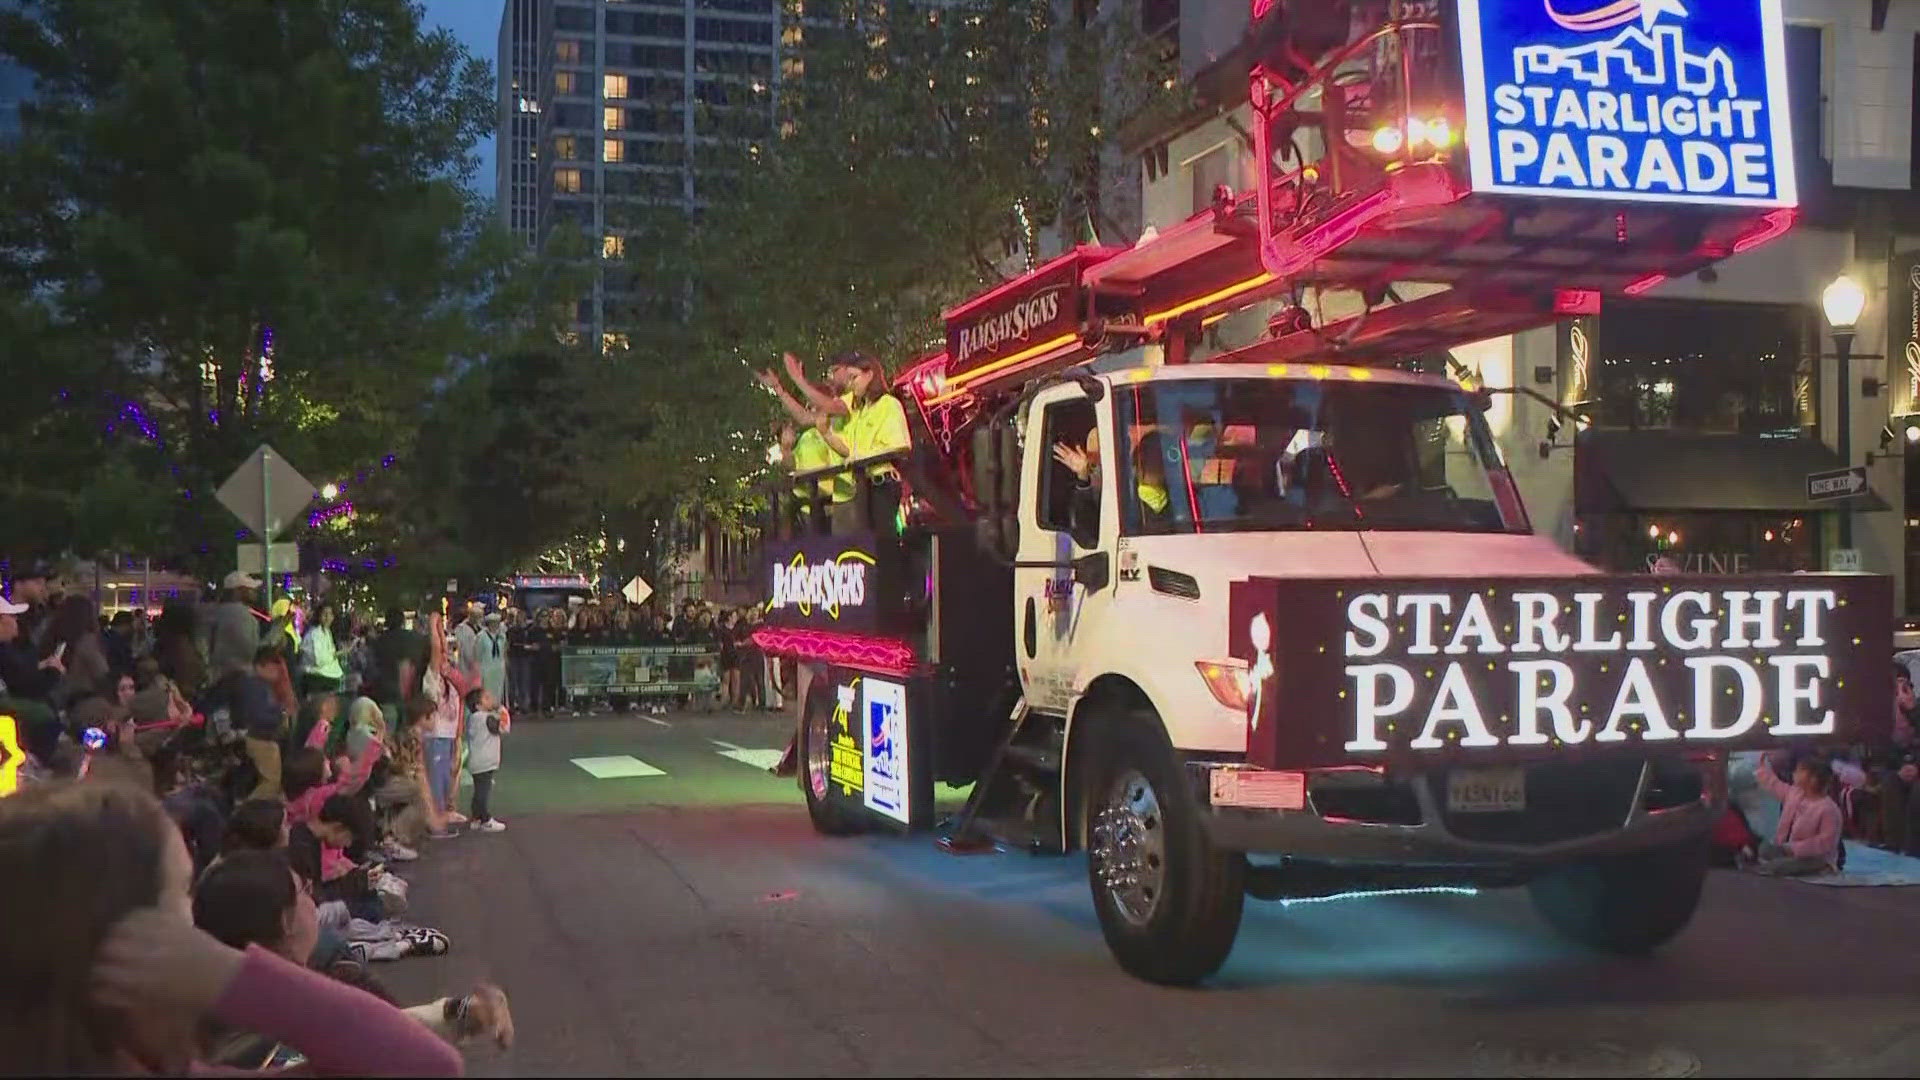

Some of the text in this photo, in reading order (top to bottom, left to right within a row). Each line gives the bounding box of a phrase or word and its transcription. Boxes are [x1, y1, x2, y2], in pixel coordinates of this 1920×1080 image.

[1494, 84, 1762, 139] STARLIGHT
[1497, 129, 1770, 195] PARADE
[1813, 477, 1850, 493] ONE WAY
[1345, 590, 1835, 657] STARLIGHT
[1344, 655, 1835, 752] PARADE
